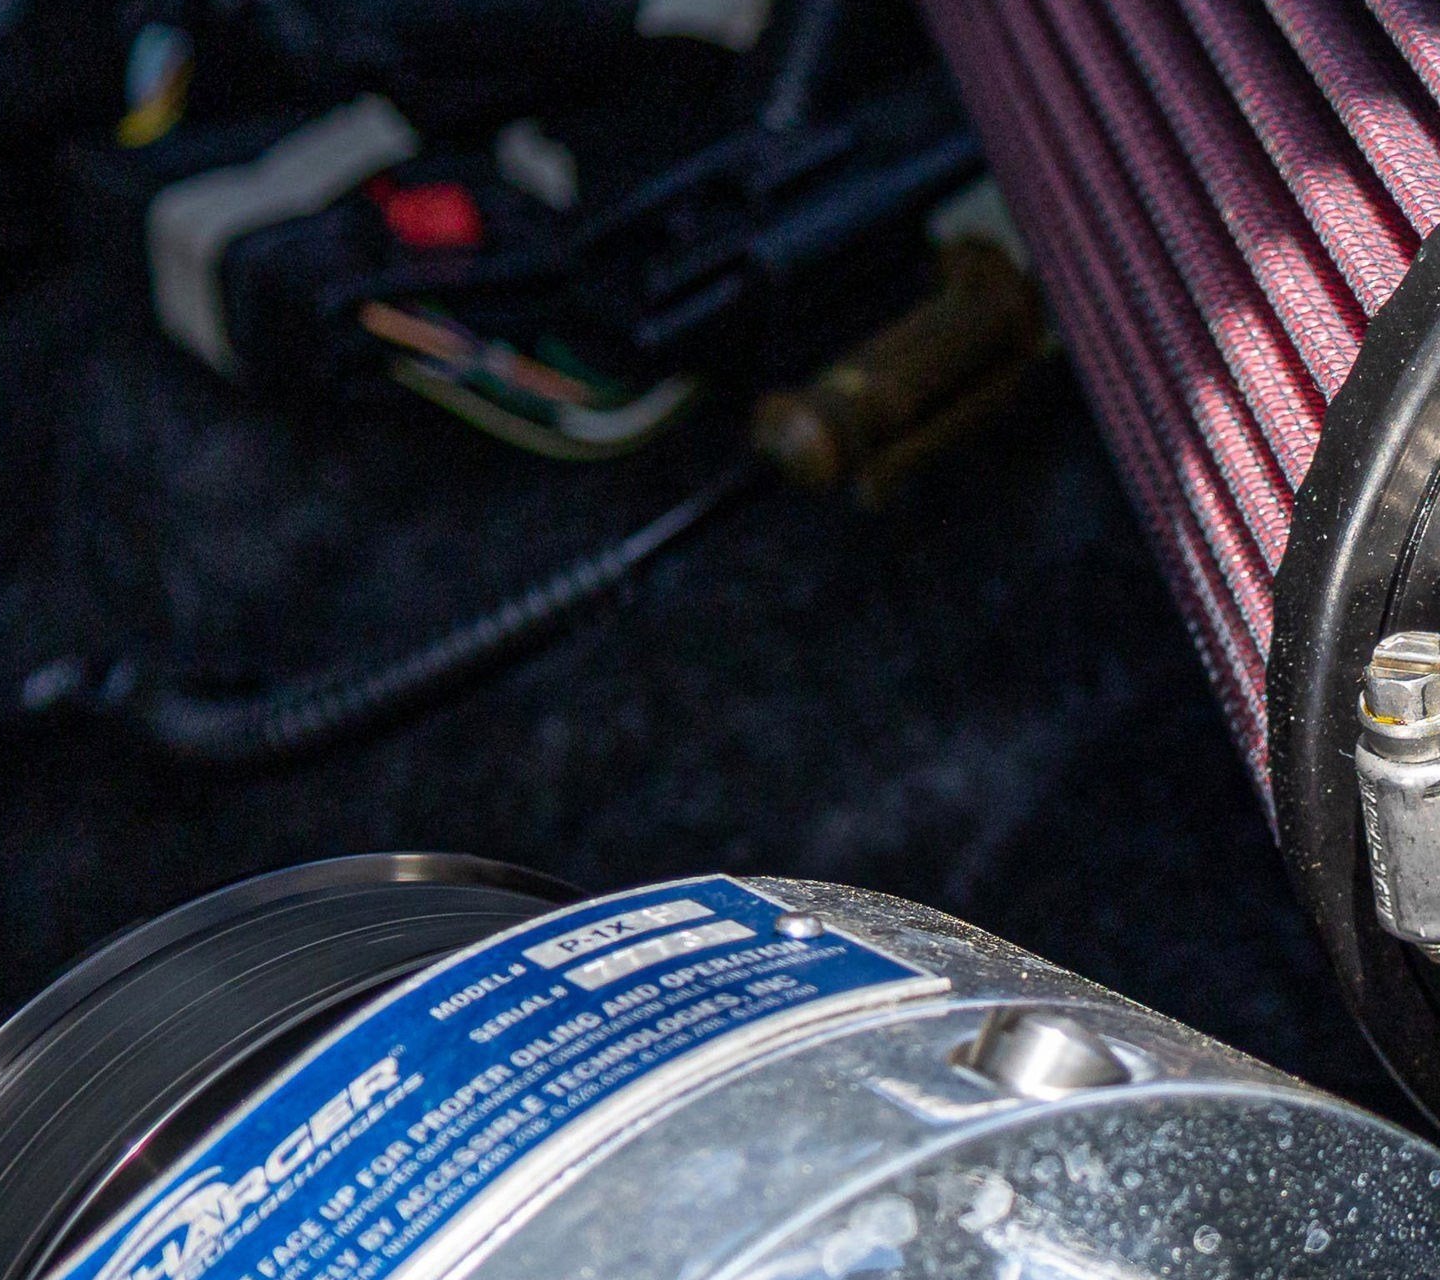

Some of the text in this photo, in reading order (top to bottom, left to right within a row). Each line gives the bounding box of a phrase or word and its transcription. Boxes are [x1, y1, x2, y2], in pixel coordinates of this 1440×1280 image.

[556, 920, 635, 953] P-1X
[256, 1219, 323, 1278] FACE
[318, 1184, 356, 1220] UP
[355, 1140, 412, 1188] FOR
[407, 1063, 512, 1143] PROPER
[509, 1011, 602, 1067] OILING
[601, 983, 660, 1018] AND
[659, 937, 810, 988] OPERATION
[357, 1217, 394, 1251] BY
[395, 1095, 544, 1219] ACCESSIBLE
